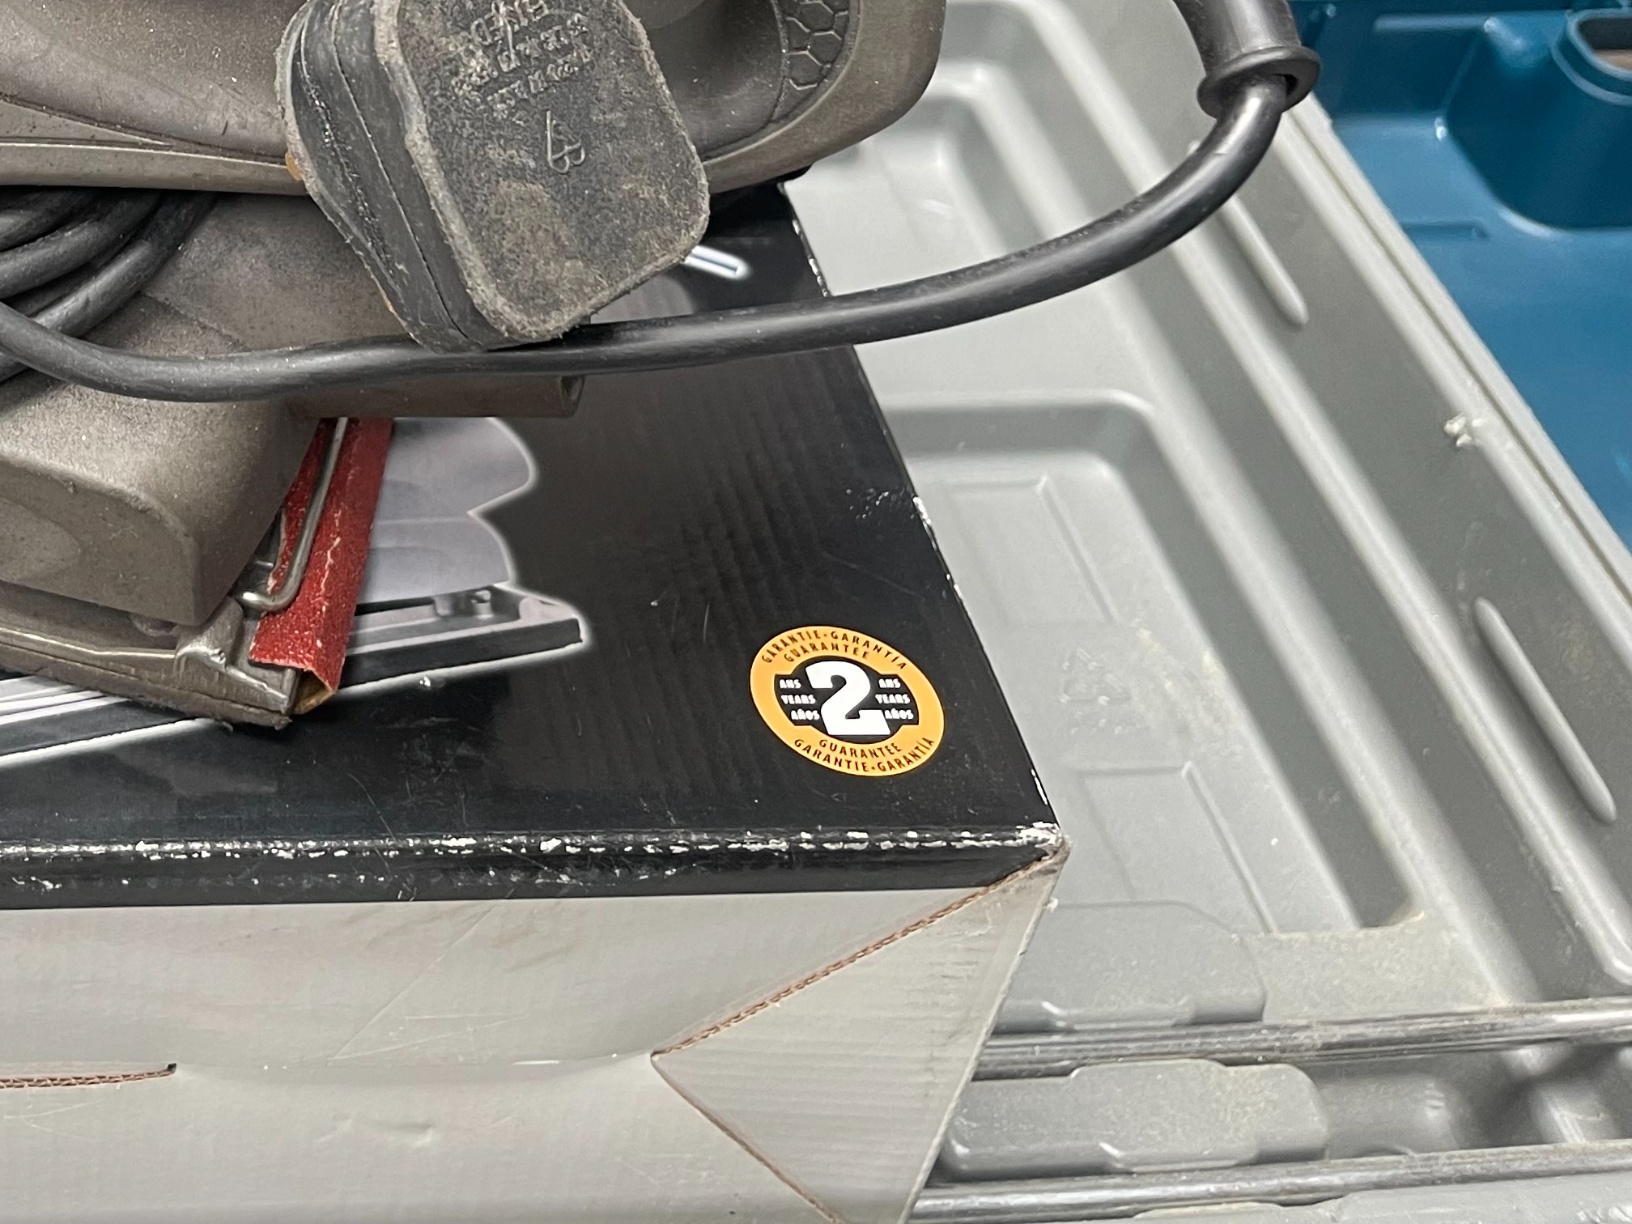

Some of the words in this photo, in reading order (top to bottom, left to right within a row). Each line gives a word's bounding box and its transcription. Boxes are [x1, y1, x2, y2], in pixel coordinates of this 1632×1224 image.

[783, 641, 870, 663] GUARANTEE
[780, 694, 817, 705] YEARS
[805, 661, 891, 736] 2
[874, 693, 911, 705] YEARS
[818, 739, 903, 759] GUARANTEE
